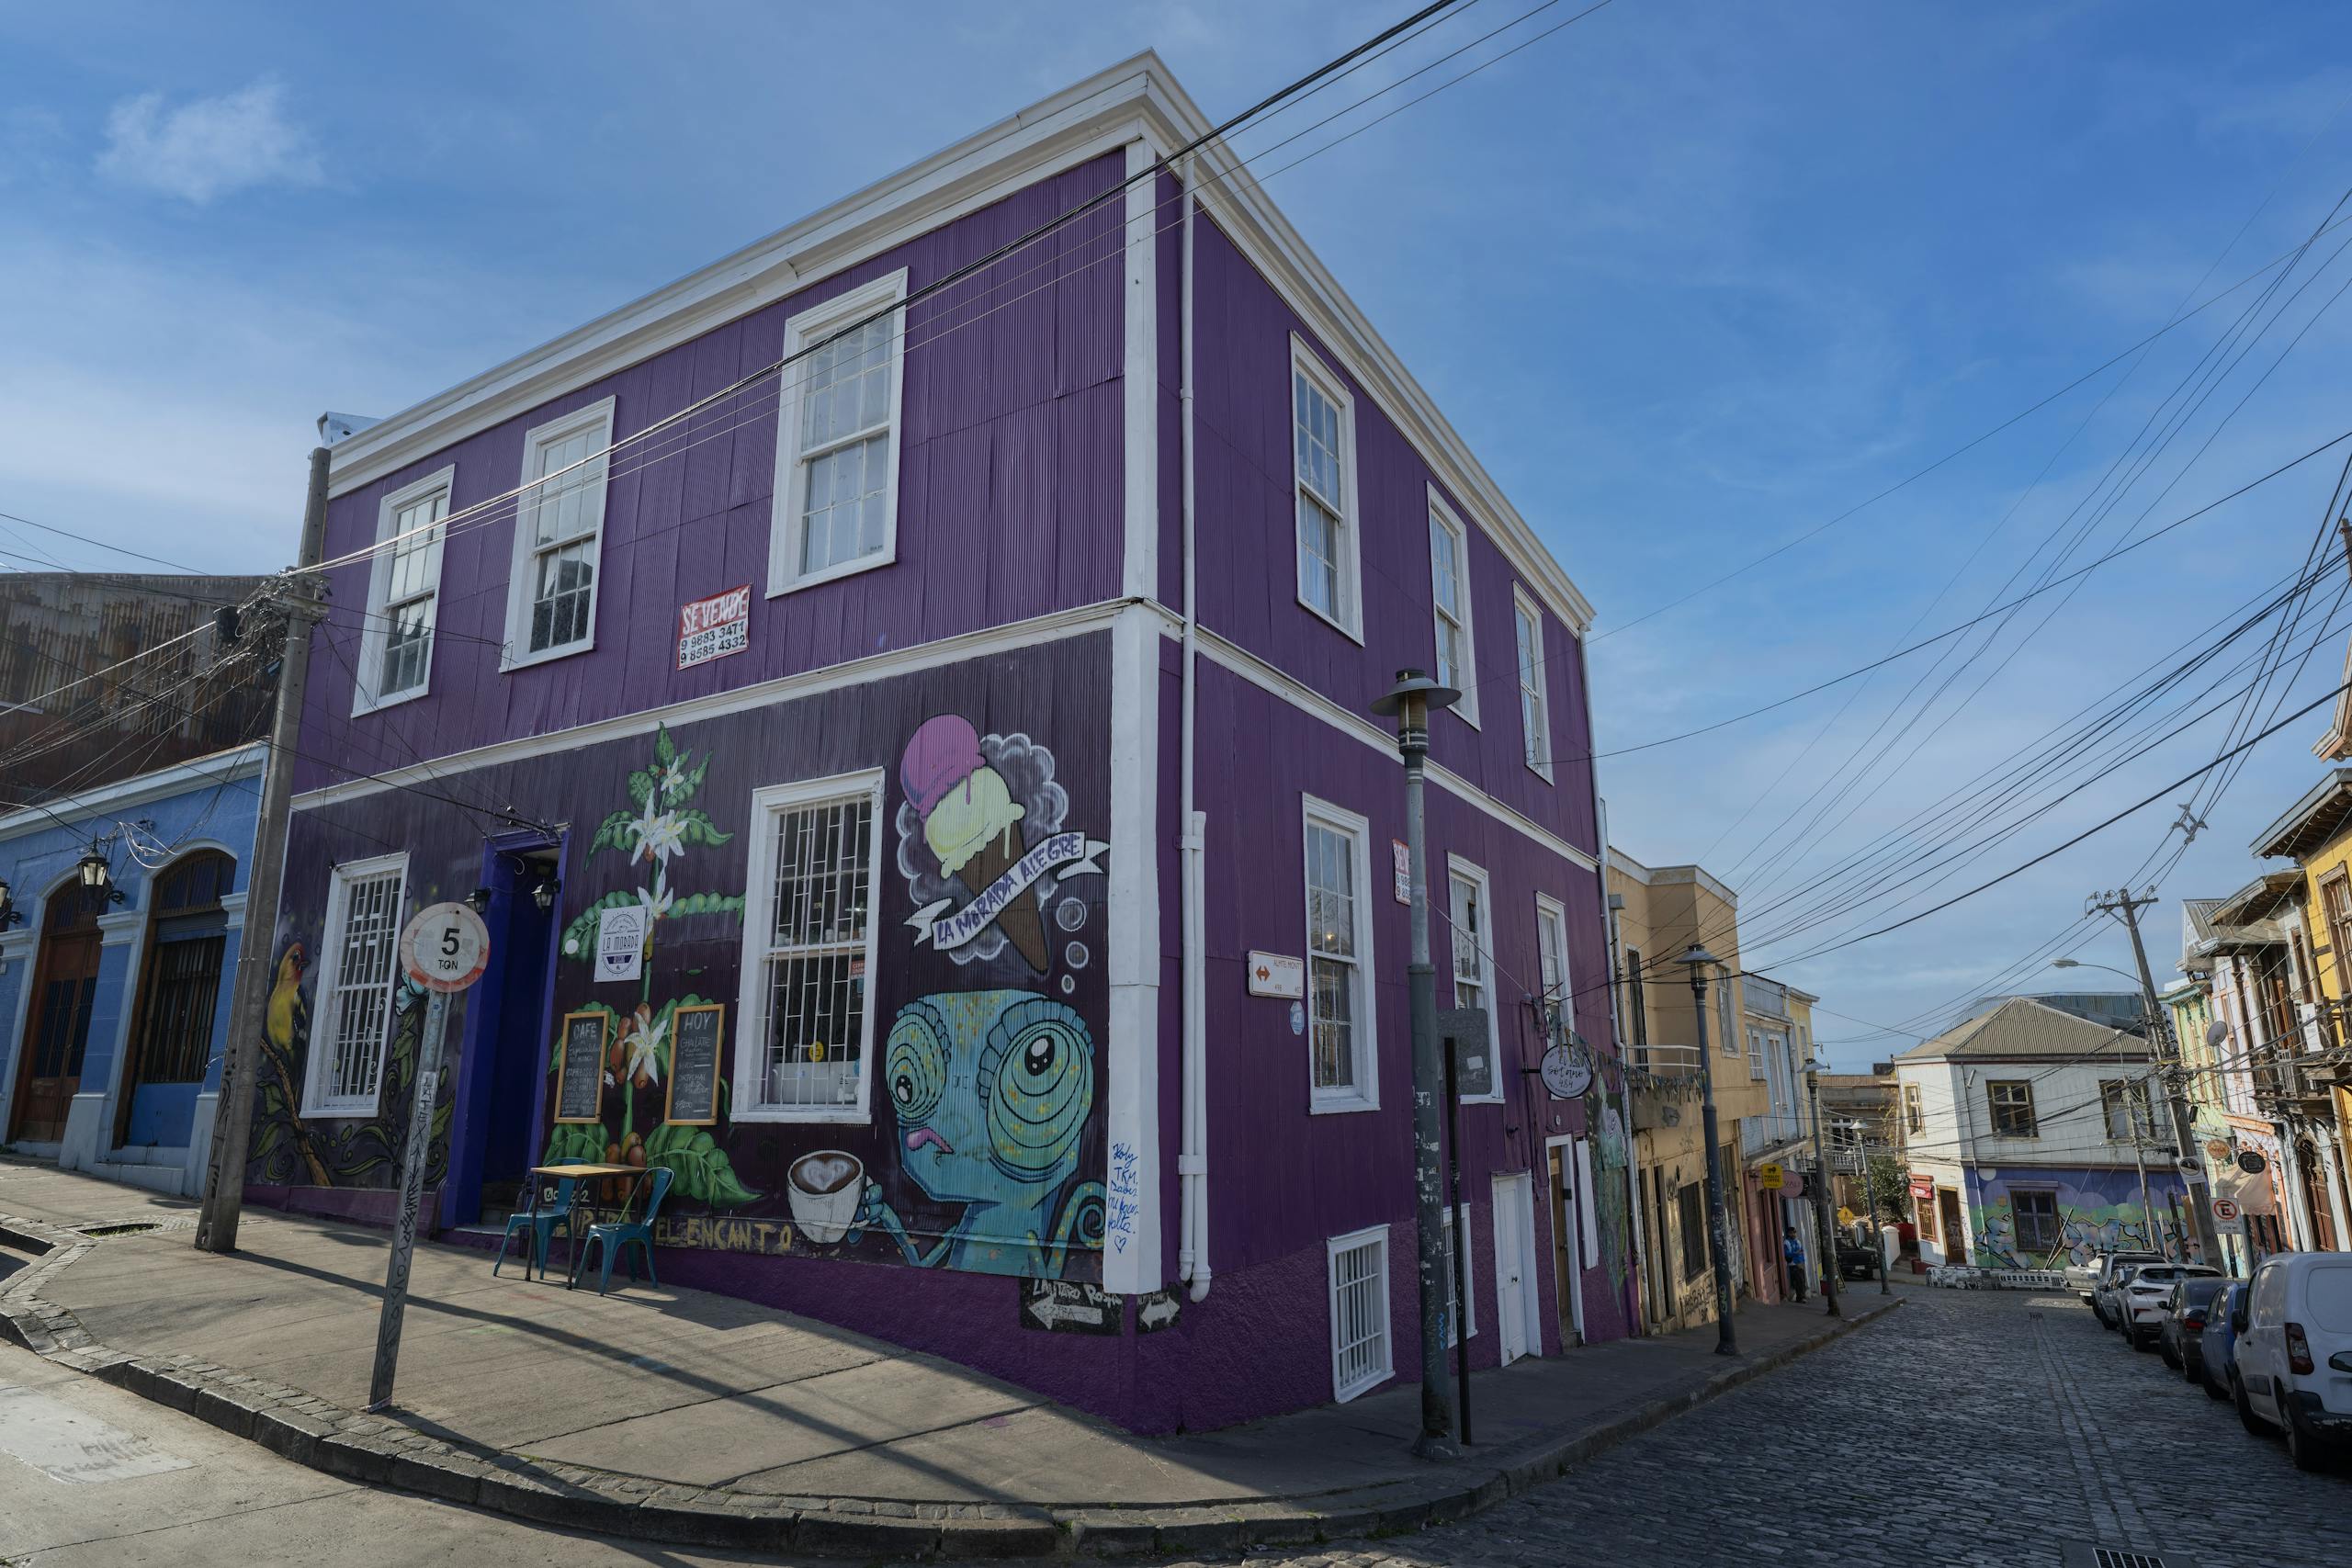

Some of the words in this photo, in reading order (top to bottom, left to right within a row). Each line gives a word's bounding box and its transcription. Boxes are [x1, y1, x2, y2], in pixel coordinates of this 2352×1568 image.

[682, 603, 699, 635] SE
[701, 586, 750, 628] VENDE
[680, 652, 686, 663] 9
[690, 644, 715, 660] 8585
[718, 634, 745, 650] 4332
[681, 639, 687, 650] 9
[691, 630, 715, 648] 9883
[441, 928, 460, 955] 5
[438, 960, 458, 970] TON
[684, 1012, 712, 1031] HOY
[685, 1218, 792, 1252] ENCANTO
